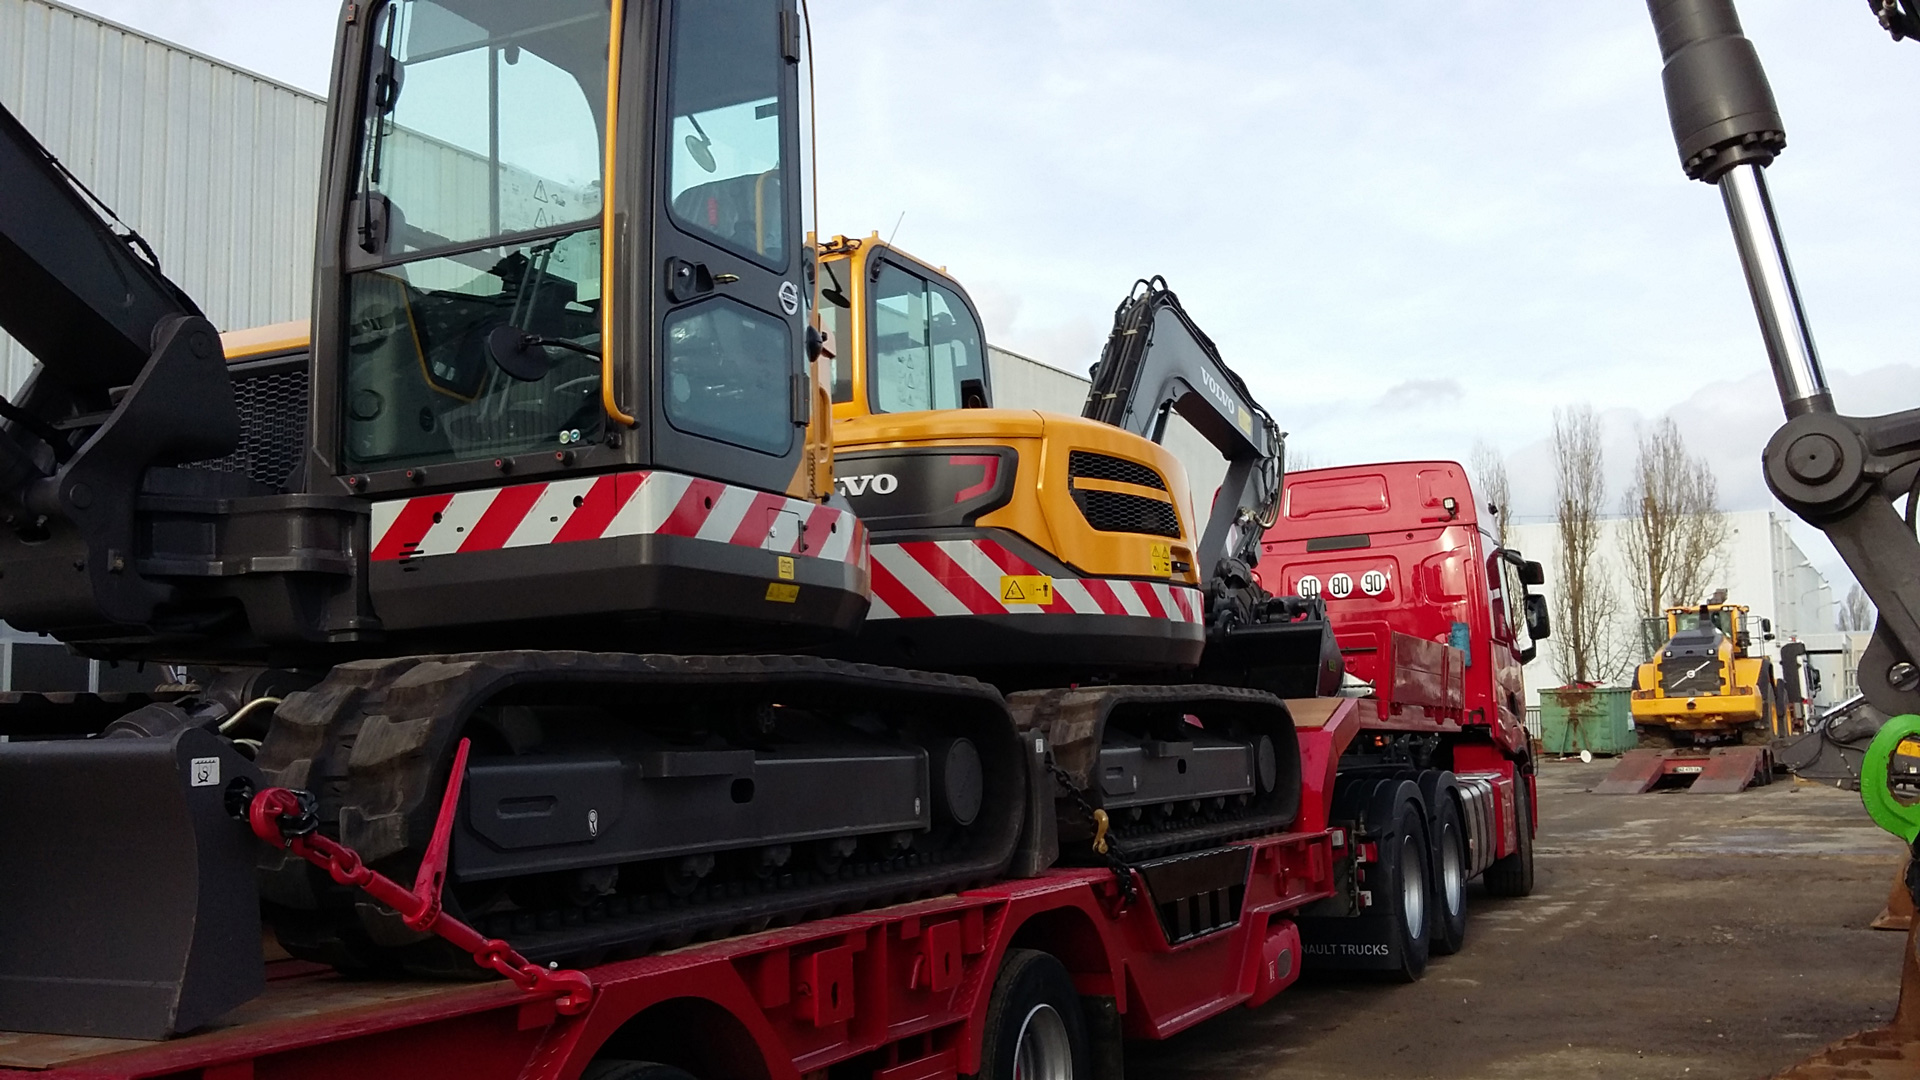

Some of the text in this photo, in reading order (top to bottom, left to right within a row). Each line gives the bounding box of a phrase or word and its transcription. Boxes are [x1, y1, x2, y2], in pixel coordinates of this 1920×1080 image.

[1200, 366, 1235, 414] VOLVO
[1301, 574, 1382, 597] 60 80 90
[1340, 944, 1389, 955] TRUCKS
